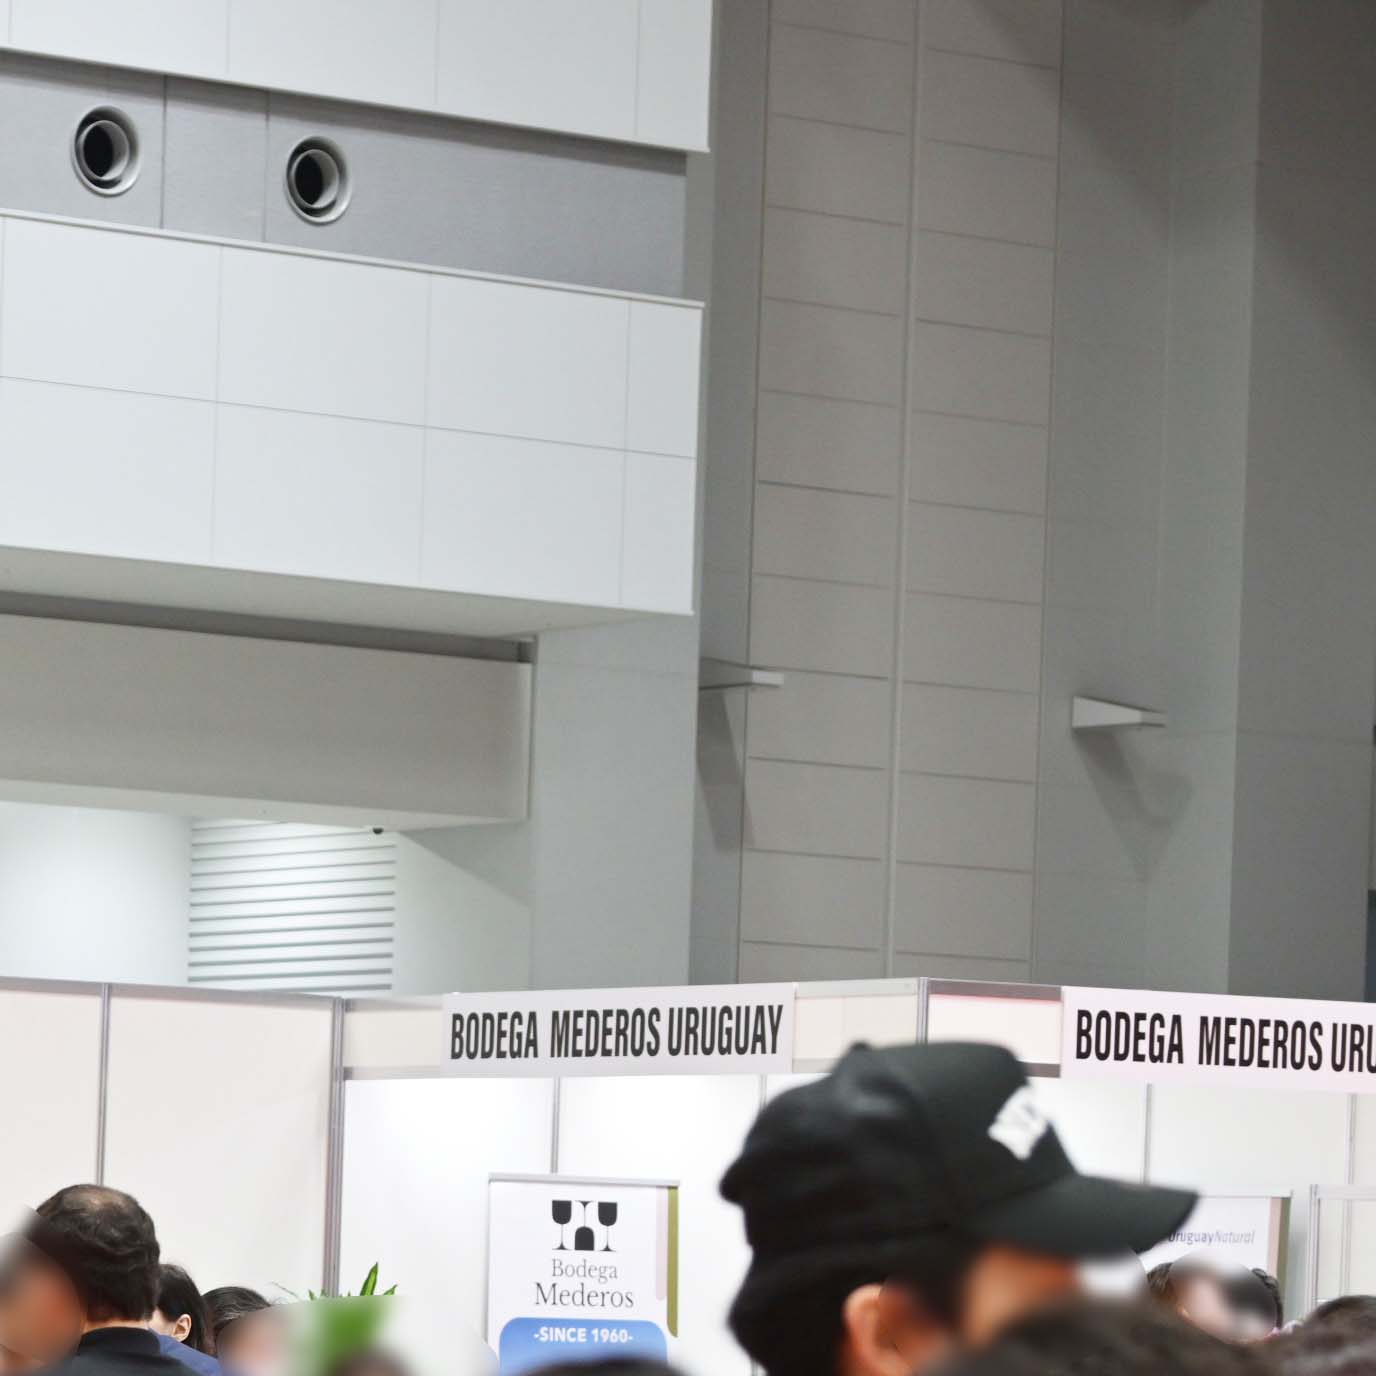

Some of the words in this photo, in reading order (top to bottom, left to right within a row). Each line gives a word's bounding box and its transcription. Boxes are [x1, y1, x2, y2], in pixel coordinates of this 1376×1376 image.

[450, 1009, 539, 1061] BODEGA
[550, 1006, 661, 1059] MEDEROS
[667, 1004, 783, 1057] URUGUAY
[1075, 1008, 1184, 1065] BODEGA
[1198, 1015, 1323, 1072] MEDEROS
[550, 1257, 619, 1282] Bodega
[534, 1281, 635, 1309] Mederos
[533, 1326, 587, 1344] -SINCE
[591, 1327, 634, 1344] 1960-
